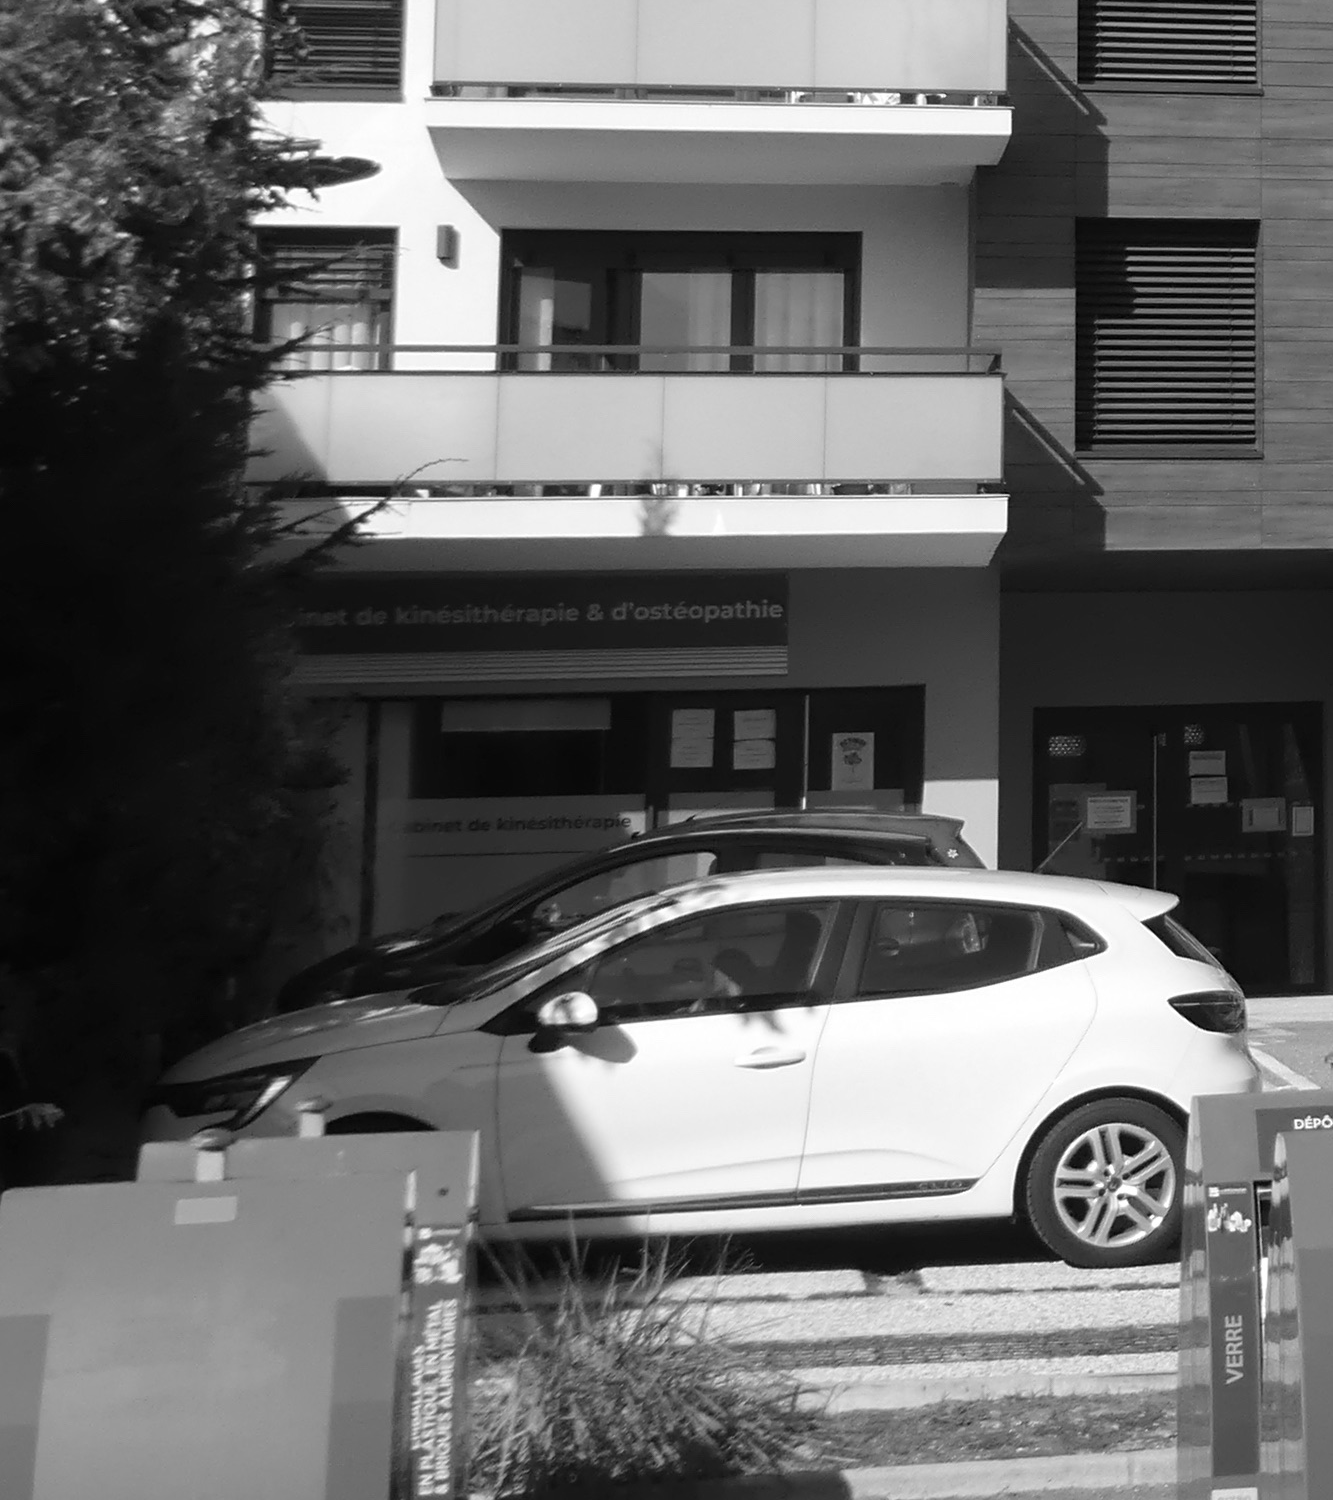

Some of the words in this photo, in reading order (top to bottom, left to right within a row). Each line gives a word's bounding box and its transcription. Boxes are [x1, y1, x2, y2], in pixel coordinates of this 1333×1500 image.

[355, 606, 387, 626] de
[395, 601, 580, 627] kinésithérapie
[585, 603, 605, 622] &
[611, 598, 784, 625] d'ostéopathie
[496, 813, 632, 832] kinésithérapie
[1224, 1314, 1245, 1386] VERRE
